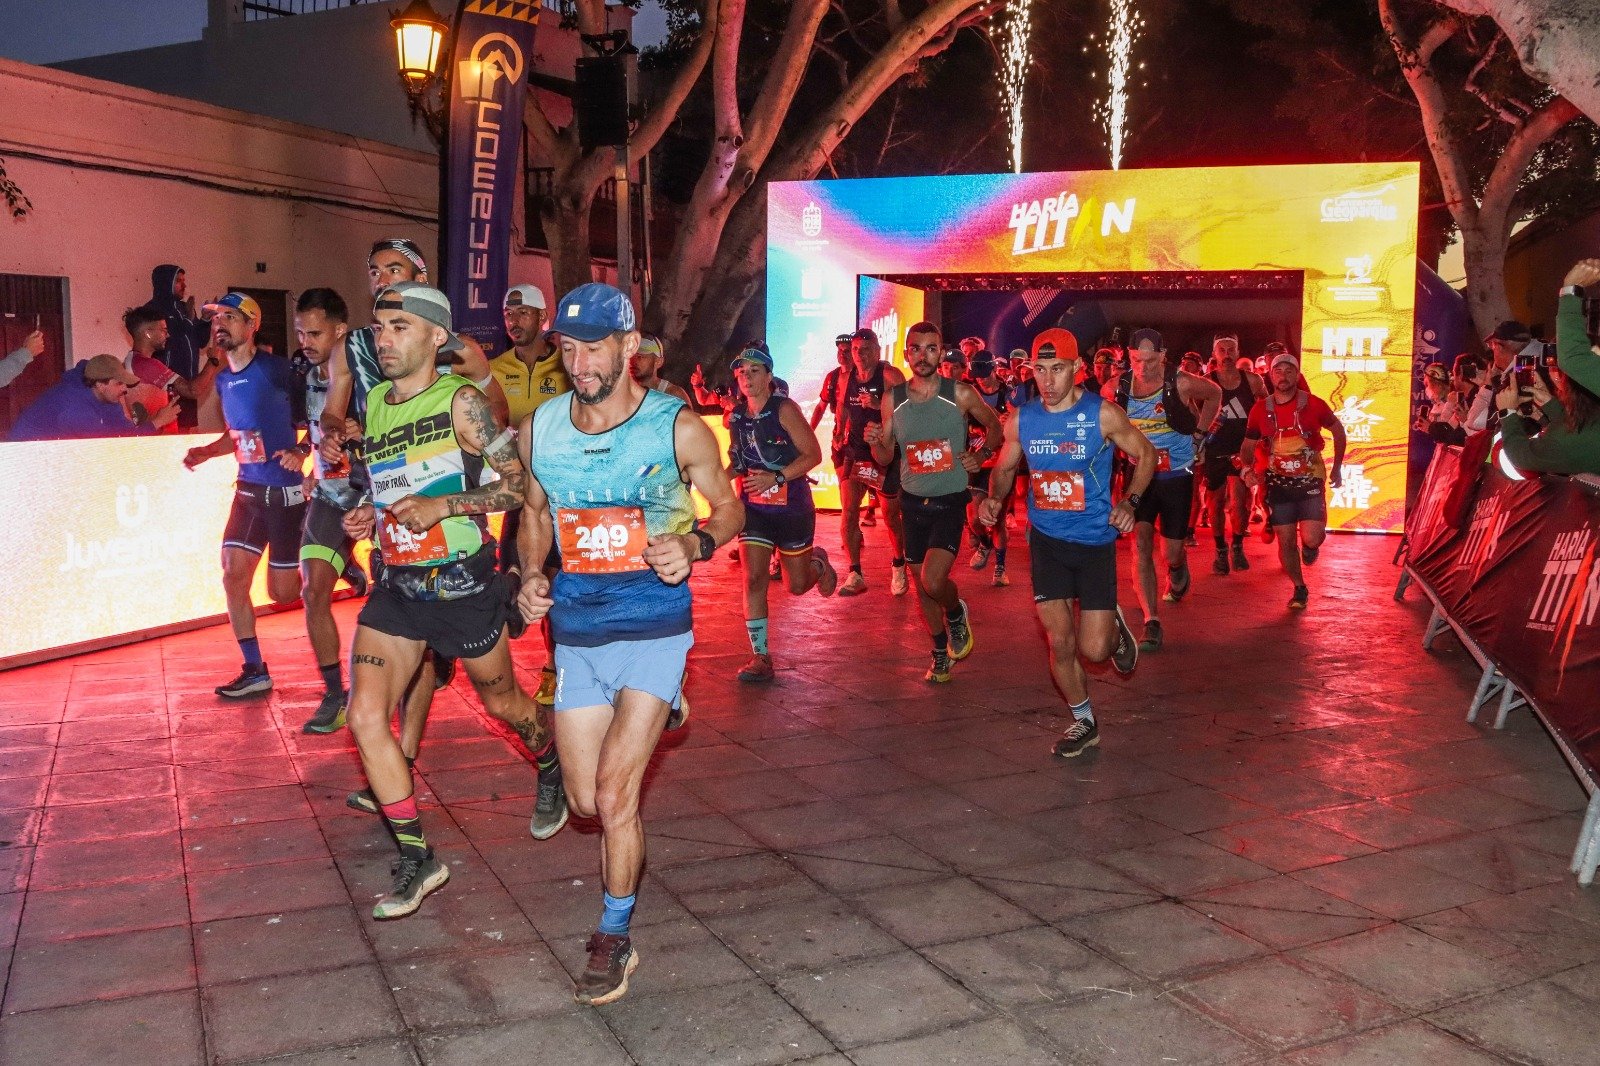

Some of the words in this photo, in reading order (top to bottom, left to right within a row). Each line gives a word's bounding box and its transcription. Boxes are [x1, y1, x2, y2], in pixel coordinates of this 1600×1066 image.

[1010, 191, 1079, 224] HARÍA
[375, 444, 407, 461] WEAR
[1029, 442, 1086, 454] OUTDOOR
[391, 473, 412, 489] TRAIL
[1548, 521, 1591, 561] HARÍA
[351, 654, 385, 667] ONGER
